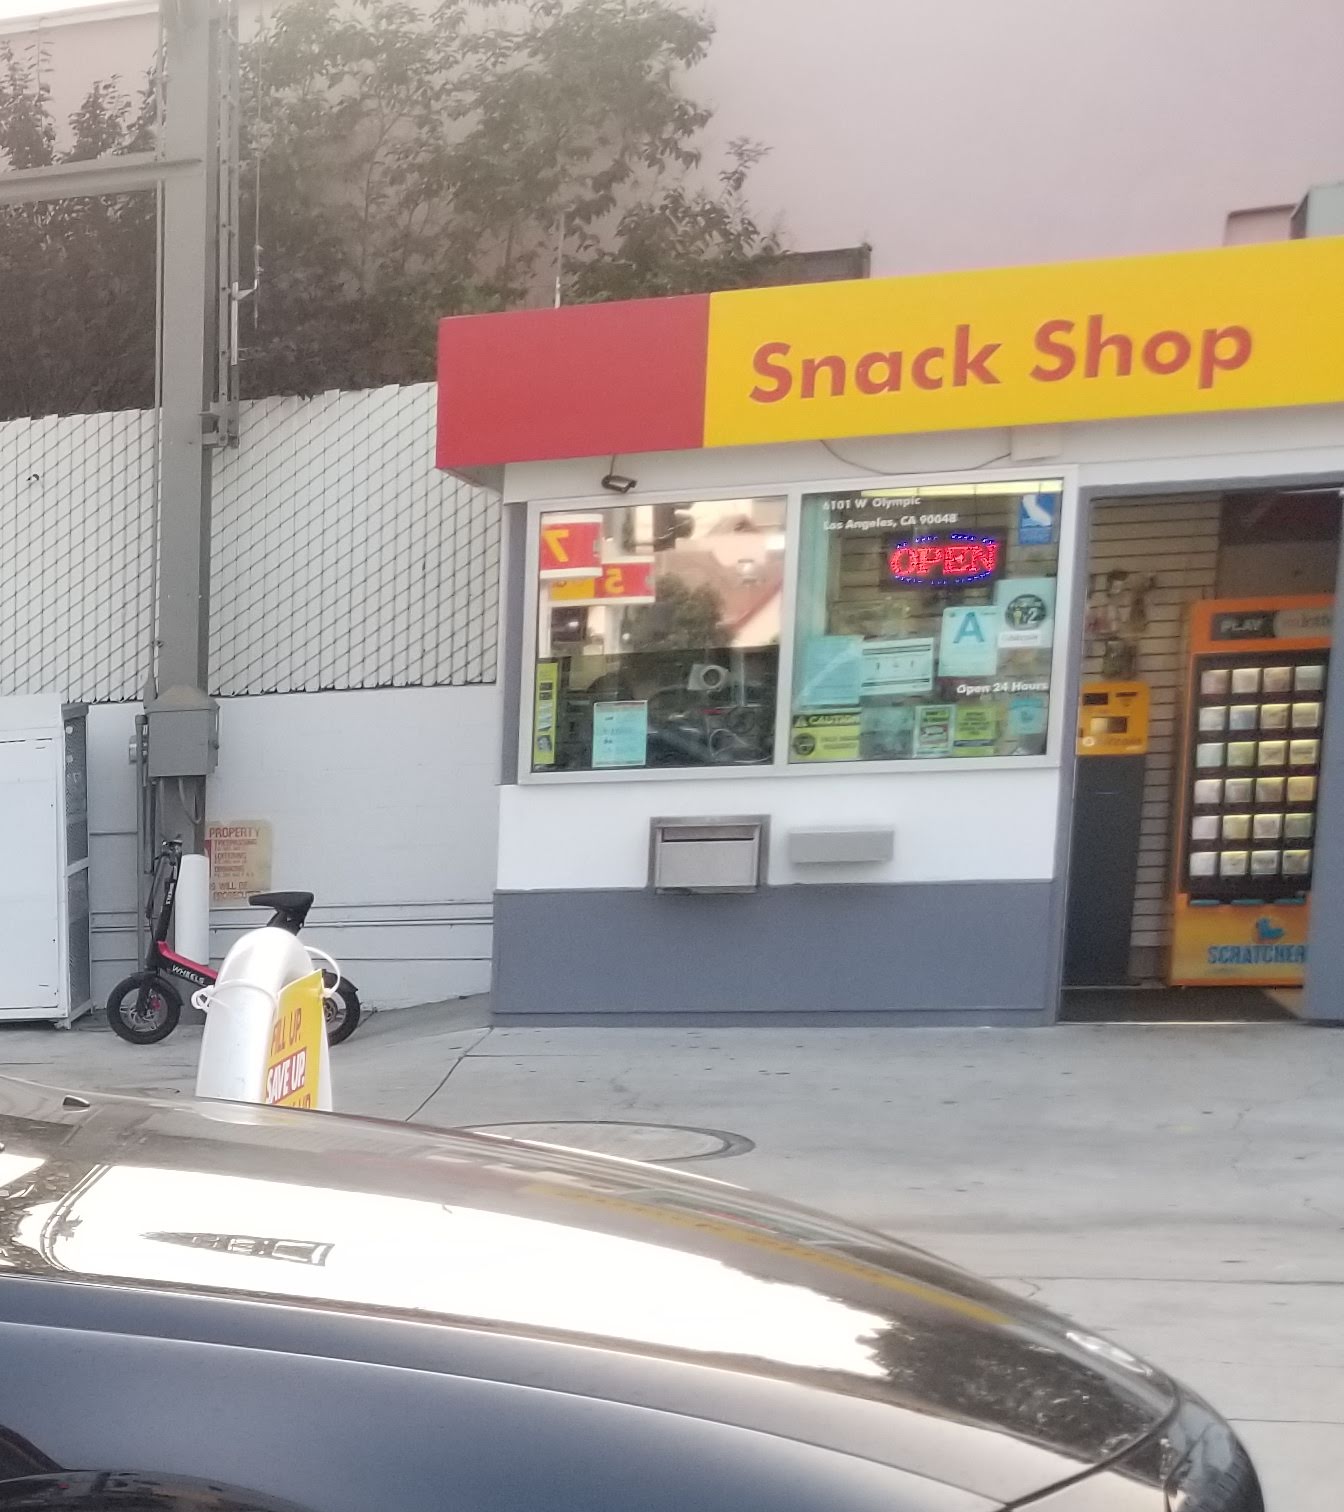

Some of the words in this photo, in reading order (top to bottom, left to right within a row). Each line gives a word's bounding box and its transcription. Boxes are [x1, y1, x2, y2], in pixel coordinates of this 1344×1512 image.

[748, 323, 1002, 404] Snack
[1029, 314, 1254, 390] Shop
[855, 499, 869, 509] W
[872, 495, 921, 510] Olympic
[900, 515, 916, 526] CA
[889, 543, 1000, 576] OPEN
[952, 611, 985, 645] A
[956, 684, 991, 696] Open
[992, 682, 1010, 693] 24
[1012, 681, 1050, 692] Hours
[209, 826, 261, 838] PROPERTY
[172, 965, 205, 985] WHEELS
[267, 1059, 291, 1104] SAVE
